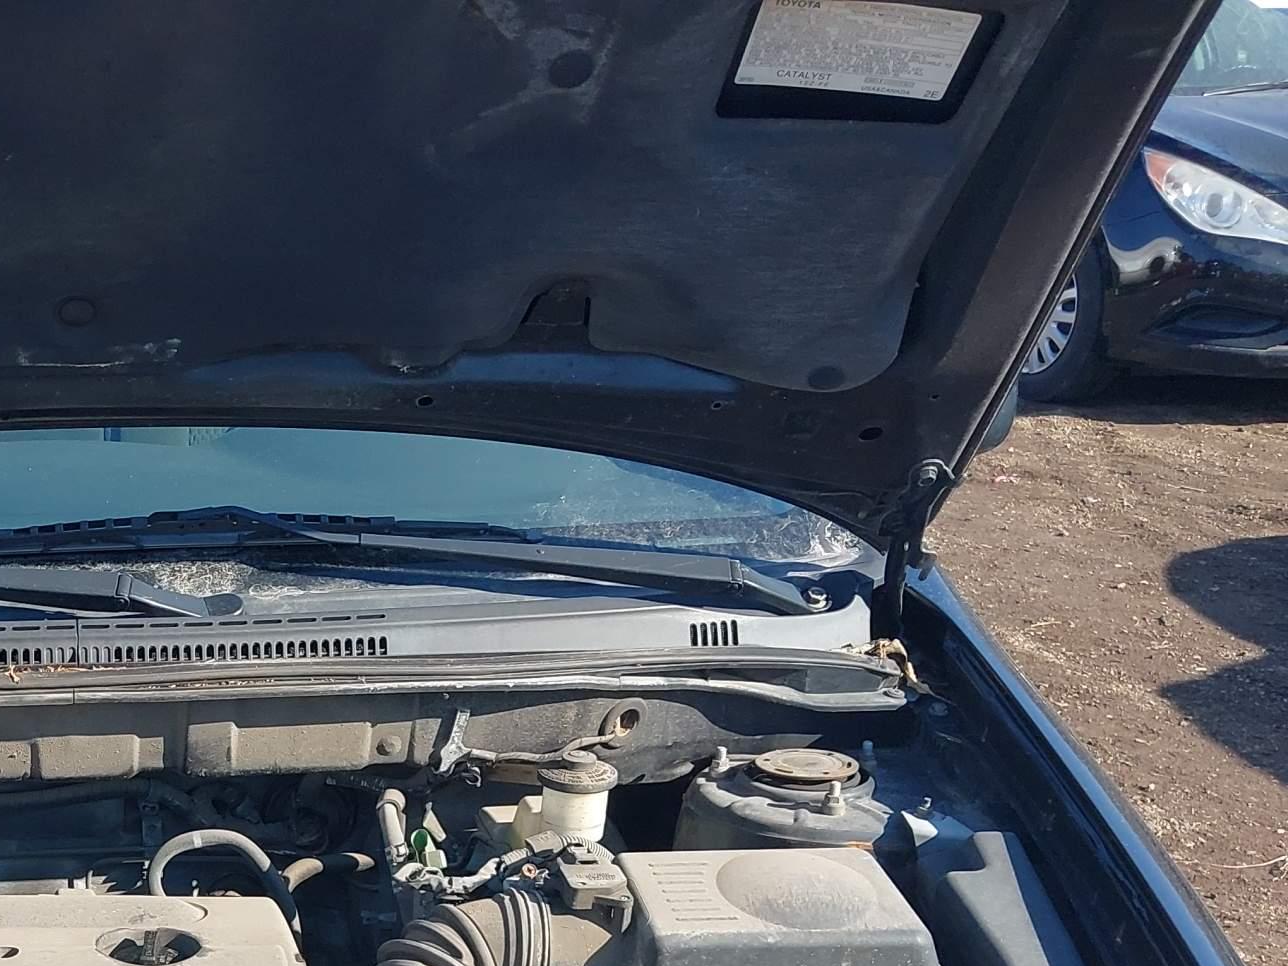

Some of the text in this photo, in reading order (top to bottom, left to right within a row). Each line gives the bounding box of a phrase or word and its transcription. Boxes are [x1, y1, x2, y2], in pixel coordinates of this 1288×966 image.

[775, 0, 821, 9] TOYOTA
[776, 69, 832, 81] CATALYST
[923, 89, 939, 99] 2E
